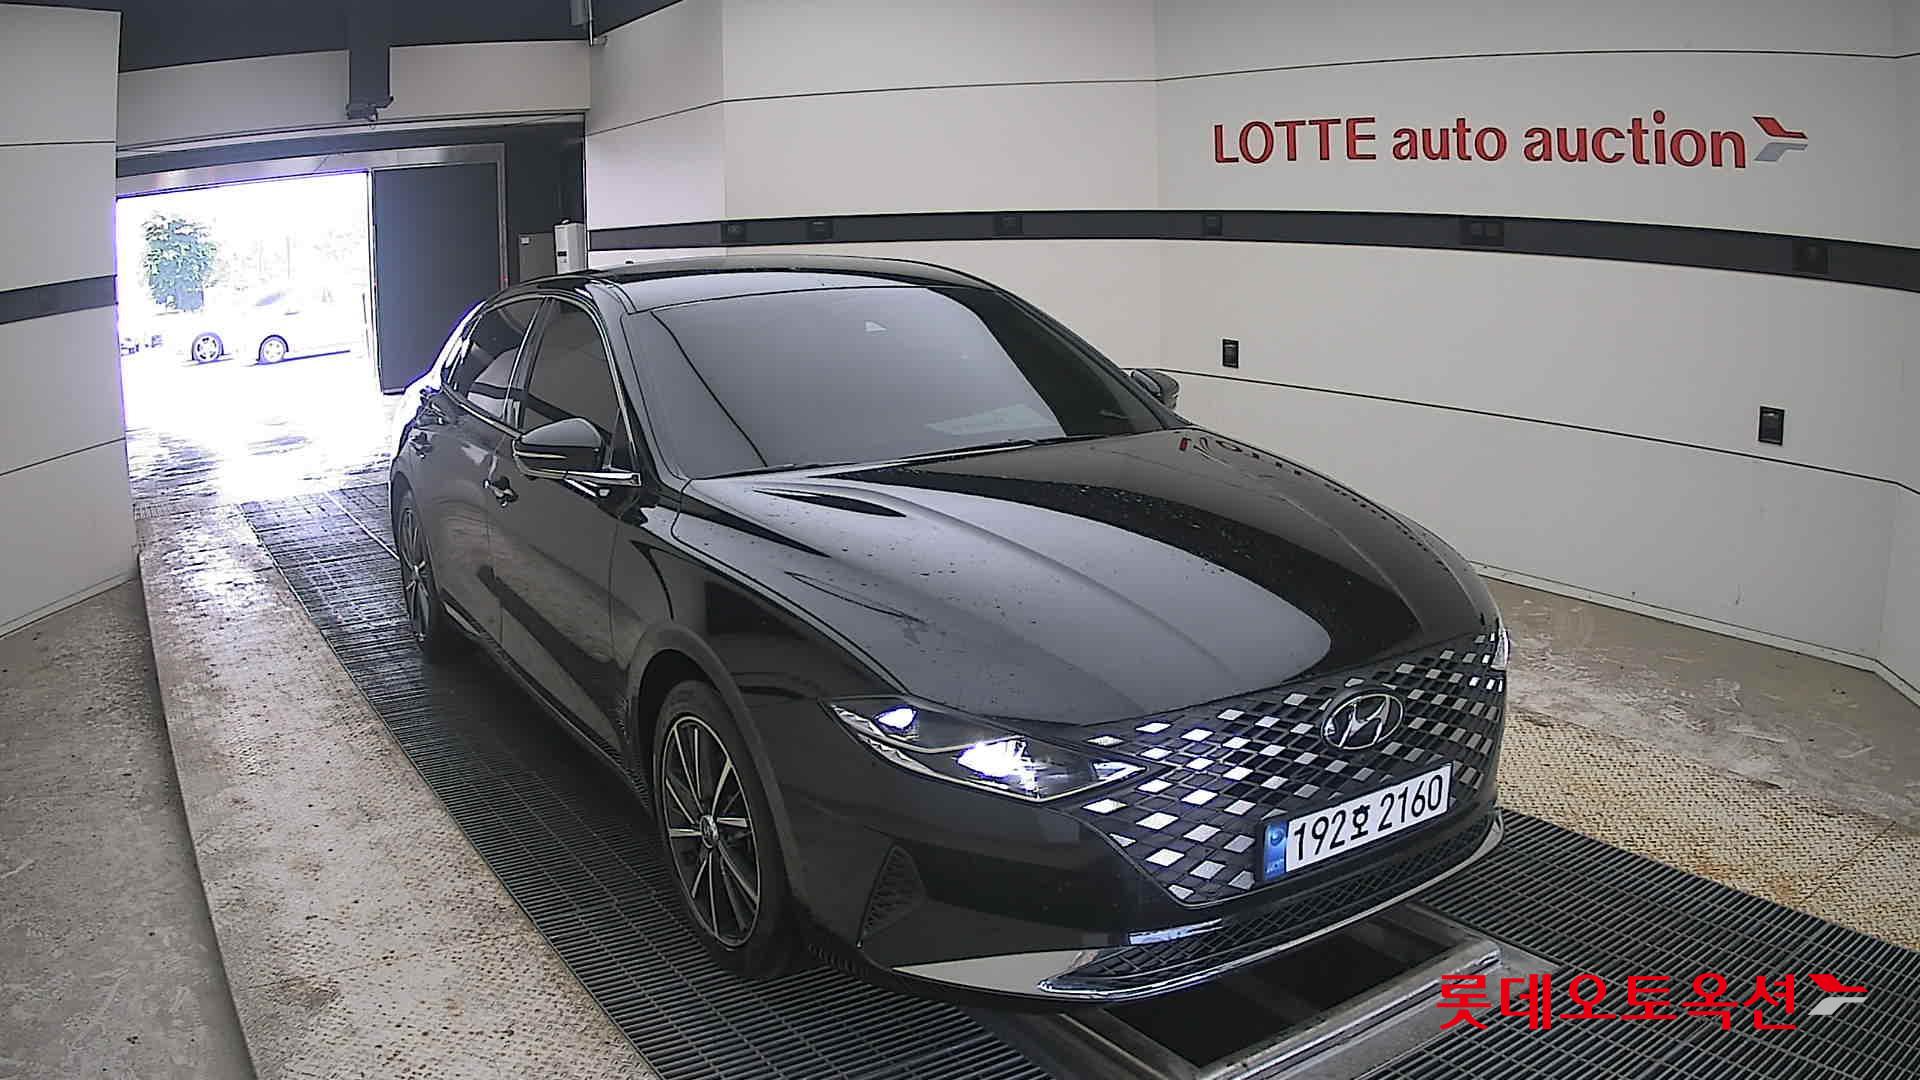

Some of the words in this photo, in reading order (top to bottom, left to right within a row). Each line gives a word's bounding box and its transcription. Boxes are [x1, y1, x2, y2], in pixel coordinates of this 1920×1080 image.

[1214, 117, 1377, 164] LOTTE
[1393, 118, 1508, 162] auto
[1523, 110, 1747, 169] auction
[1294, 804, 1371, 861] 192호
[1378, 774, 1443, 832] 2160
